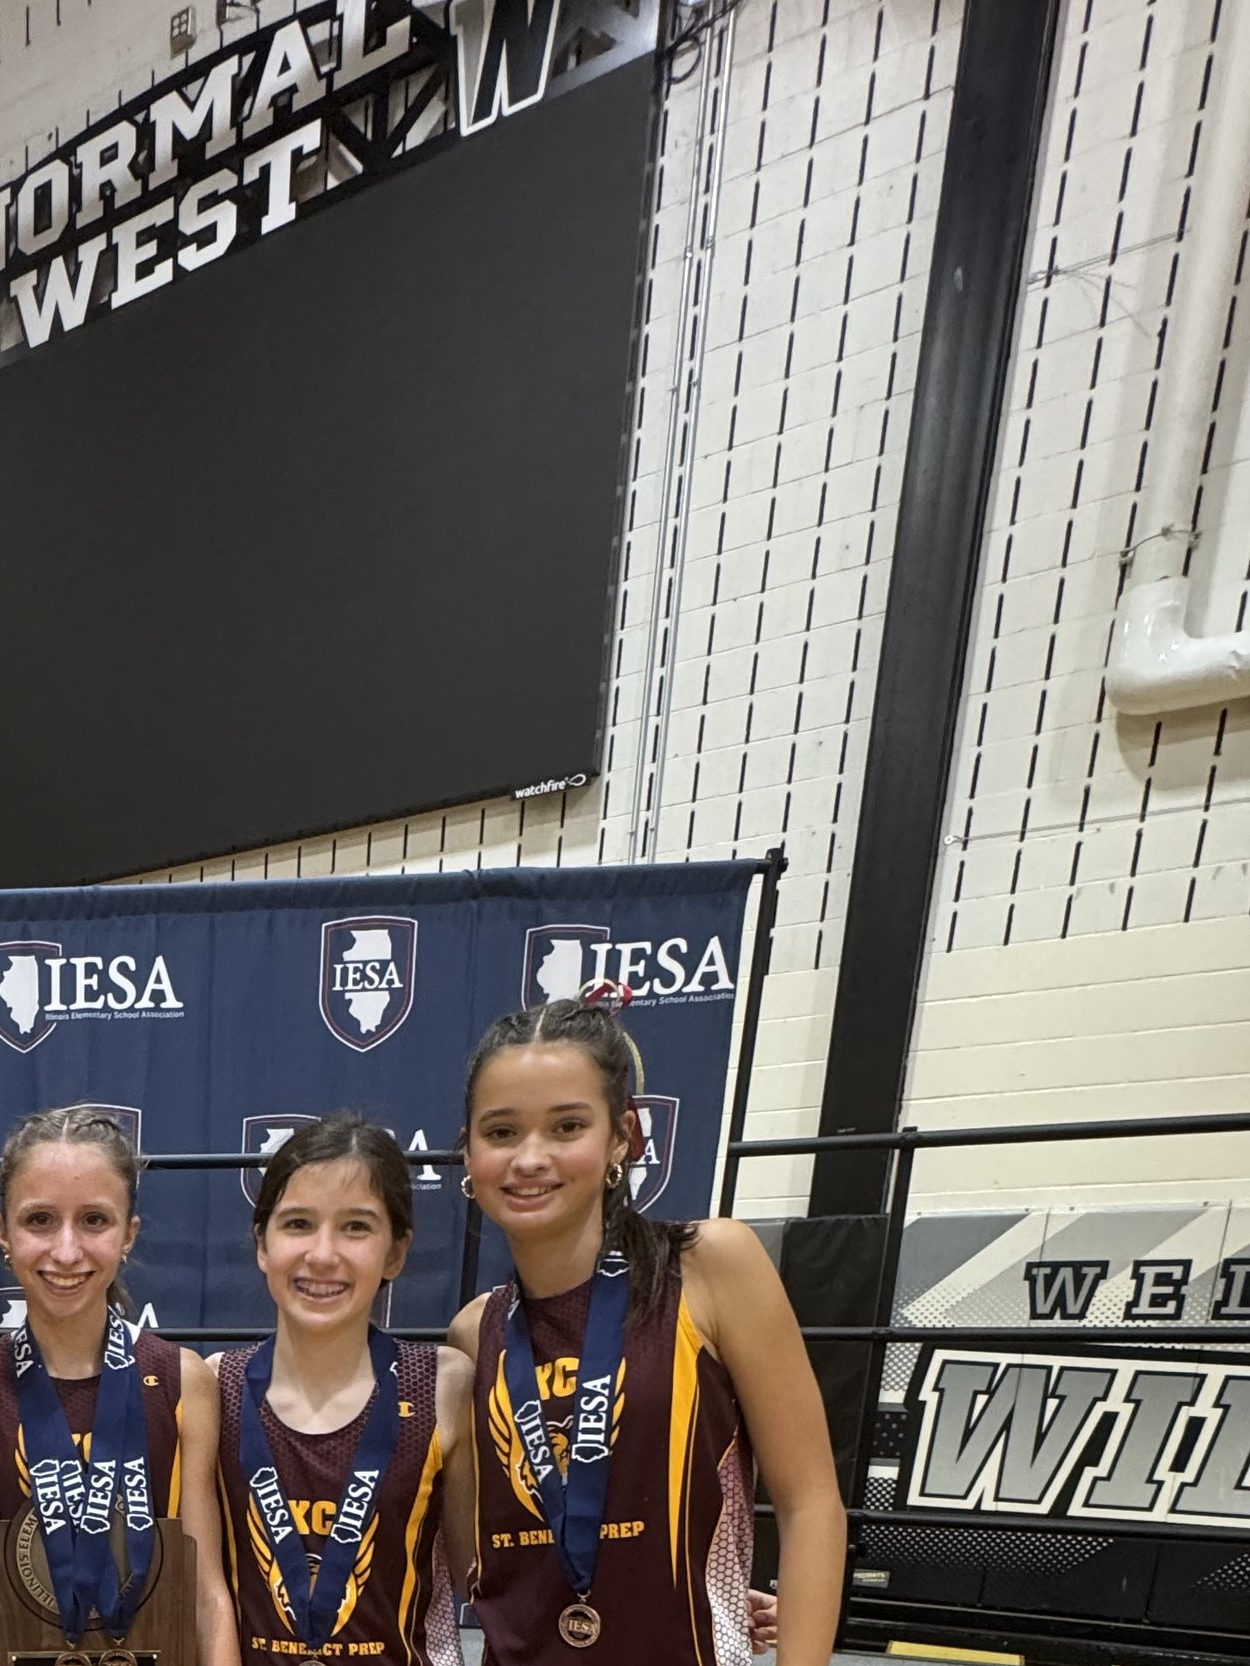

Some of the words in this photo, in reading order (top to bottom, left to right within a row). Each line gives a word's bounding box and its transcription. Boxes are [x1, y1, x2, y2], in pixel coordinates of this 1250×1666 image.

[11, 118, 321, 349] WEST
[515, 779, 566, 799] watchfire
[44, 955, 184, 1011] IESA
[331, 961, 405, 991] IESA
[584, 935, 735, 998] IESA
[45, 1012, 70, 1021] Illinois
[71, 1011, 112, 1021] Elementary
[113, 1011, 140, 1020] School
[141, 1010, 185, 1019] Association
[658, 995, 687, 1005] School
[577, 1375, 612, 1443] IESA
[520, 1416, 554, 1484] IESA
[24, 1473, 67, 1536] IESA
[86, 1459, 116, 1523] IESA
[123, 1456, 150, 1515] IESA
[257, 1481, 294, 1545] IESA
[338, 1469, 380, 1530] IESA
[491, 1533, 515, 1549] ST.
[599, 1520, 645, 1540] PREP
[18, 1553, 56, 1606] ILLINOIS
[348, 1641, 386, 1656] PREP
[568, 1619, 597, 1634] IESA
